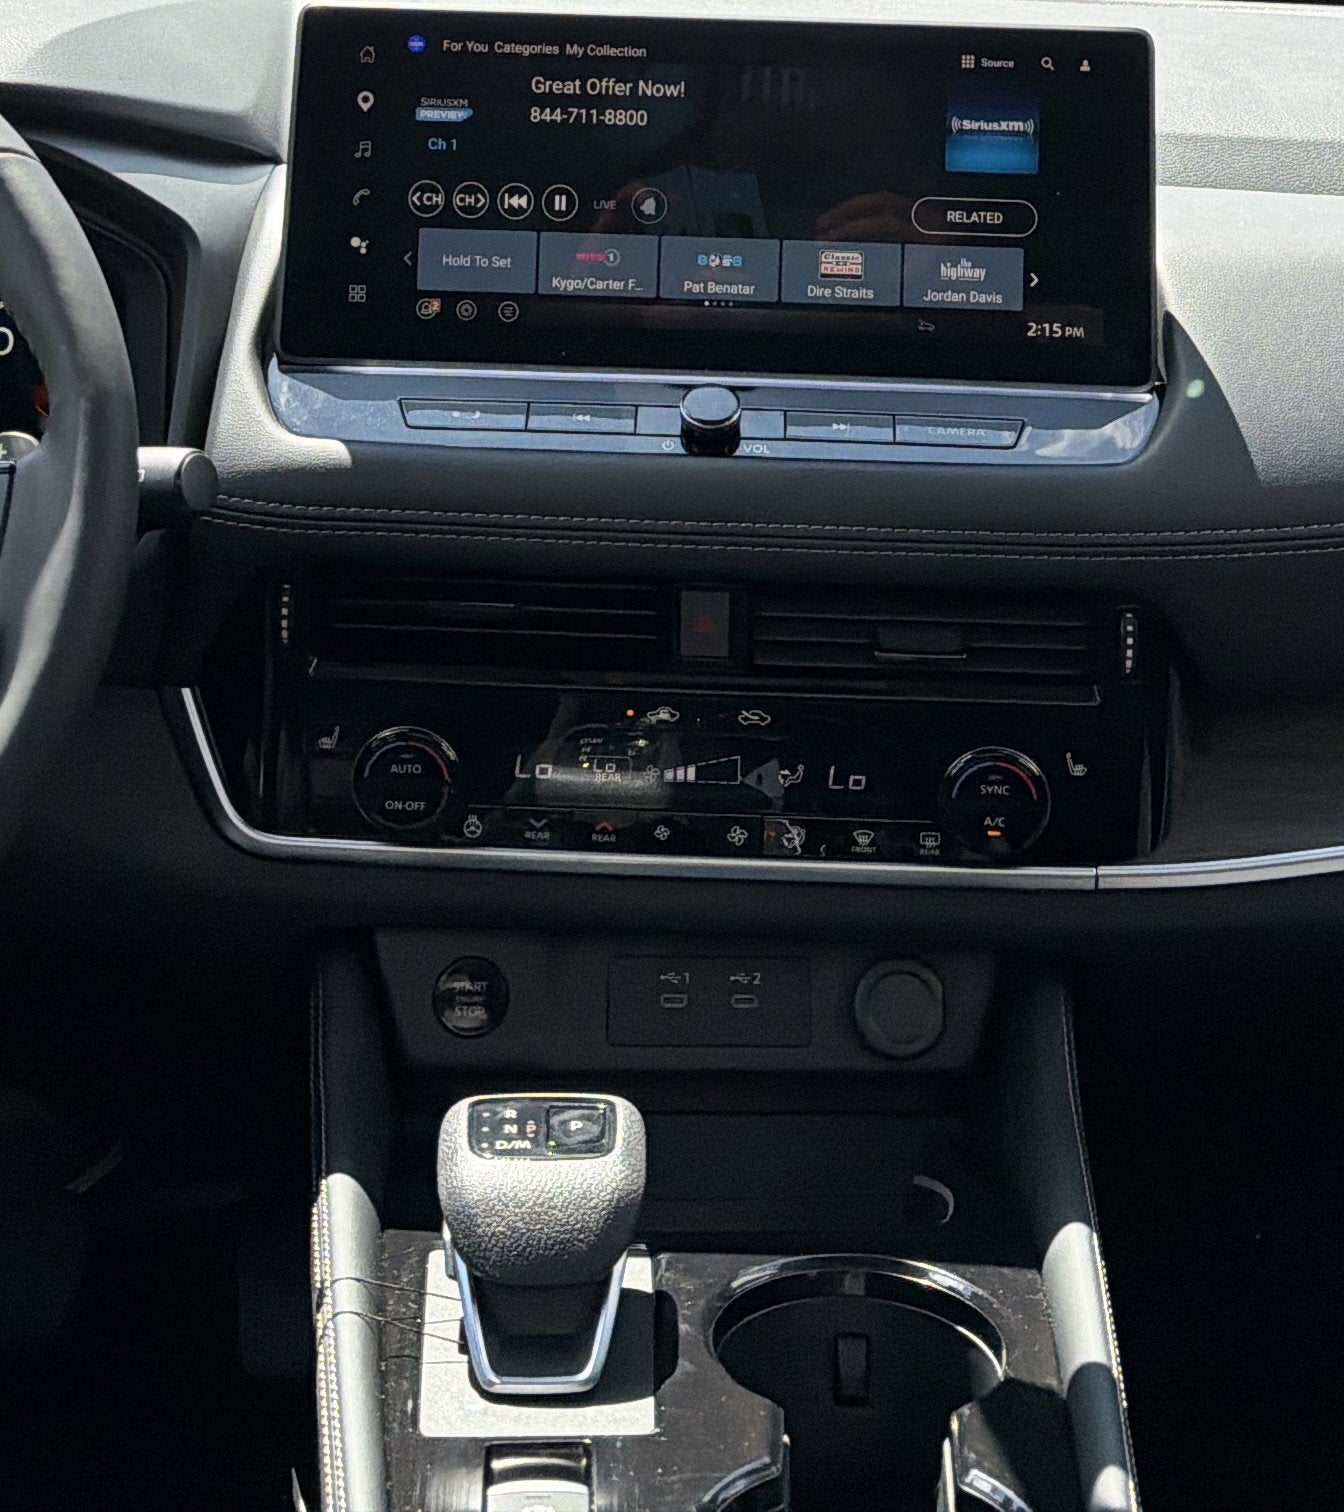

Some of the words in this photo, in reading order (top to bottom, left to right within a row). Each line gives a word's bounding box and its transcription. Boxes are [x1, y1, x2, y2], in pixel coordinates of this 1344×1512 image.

[443, 40, 463, 52] For
[466, 41, 489, 53] You
[494, 41, 559, 56] Categories
[565, 43, 584, 57] My
[587, 44, 647, 57] Collection
[981, 58, 1015, 69] Source
[531, 76, 581, 94] Great
[586, 77, 633, 96] Offer
[638, 79, 686, 97] Now!
[420, 109, 465, 119] PREVIEW
[530, 106, 649, 126] 844-711-8800
[428, 138, 446, 150] Ch
[451, 139, 457, 150] 1
[422, 193, 442, 205] CH
[456, 194, 475, 207] CH
[593, 200, 617, 211] LIVE
[947, 211, 1003, 224] RELATED
[442, 254, 472, 267] Hold
[474, 255, 489, 267] To
[492, 256, 512, 268] Set
[941, 263, 987, 281] highway
[552, 276, 625, 292] Kygo/Carter
[684, 281, 705, 293] Pat
[708, 281, 756, 295] Benatar
[807, 285, 832, 298] Dire
[835, 286, 874, 300] Straits
[923, 290, 967, 303] Jordan
[970, 291, 1003, 304] Davis
[1027, 322, 1063, 338] 2:15
[1065, 326, 1085, 338] PM
[927, 426, 987, 437] CAMERA
[743, 443, 770, 454] VOL
[390, 763, 422, 775] AUTO
[515, 754, 553, 779] Lo
[594, 772, 622, 783] REAR
[828, 765, 866, 790] Lo
[979, 784, 1011, 796] SYNC
[385, 800, 426, 812] ON-OFF
[983, 816, 1006, 828] A/C
[524, 831, 550, 840] REAR
[591, 834, 617, 843] REAR
[851, 845, 877, 855] FRONT
[683, 973, 690, 984] 1
[753, 973, 761, 984] 2
[503, 1124, 518, 1133] N
[569, 1120, 584, 1131] P
[494, 1140, 532, 1149] D/M
